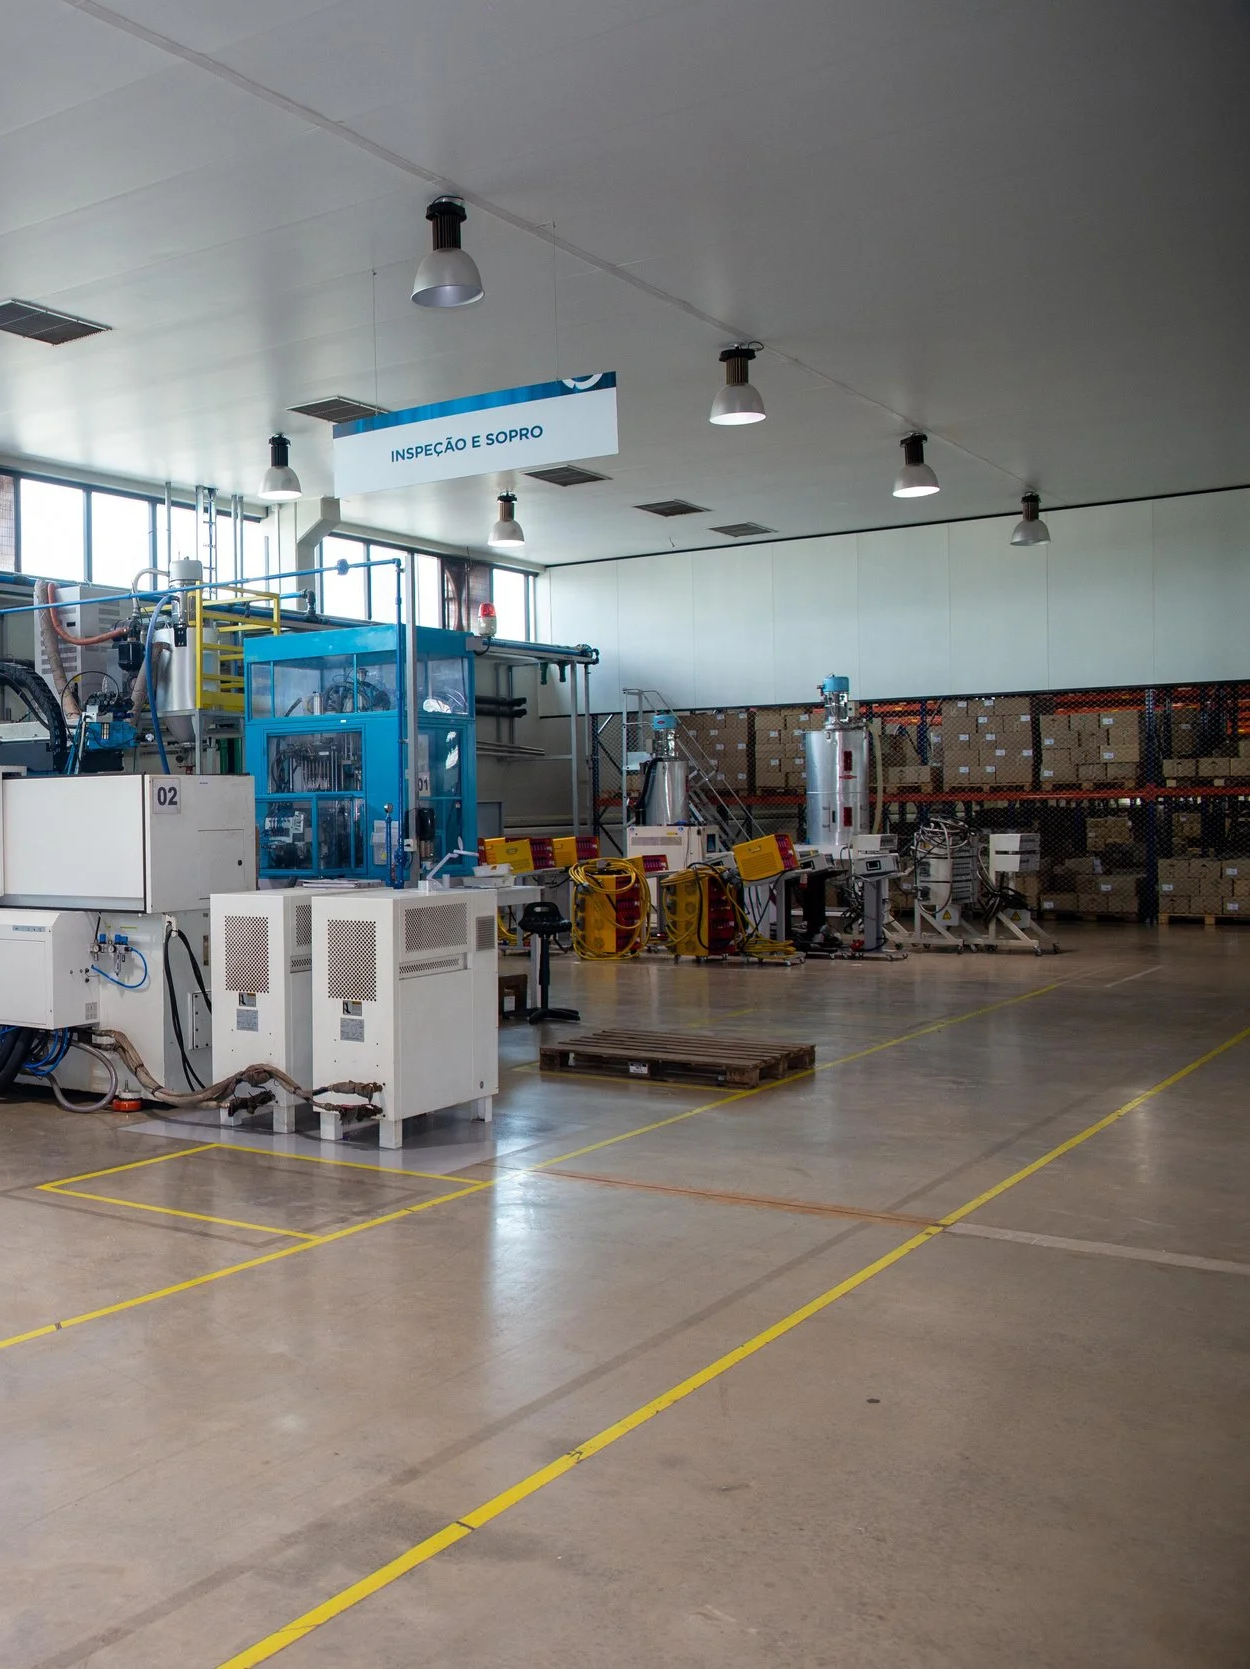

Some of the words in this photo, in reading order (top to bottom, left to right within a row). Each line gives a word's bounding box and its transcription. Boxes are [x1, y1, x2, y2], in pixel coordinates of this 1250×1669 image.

[391, 436, 467, 462] INSPEÇÃO
[471, 435, 481, 448] E
[485, 425, 544, 446] SOPRO
[417, 778, 429, 791] 01
[157, 786, 178, 806] 02
